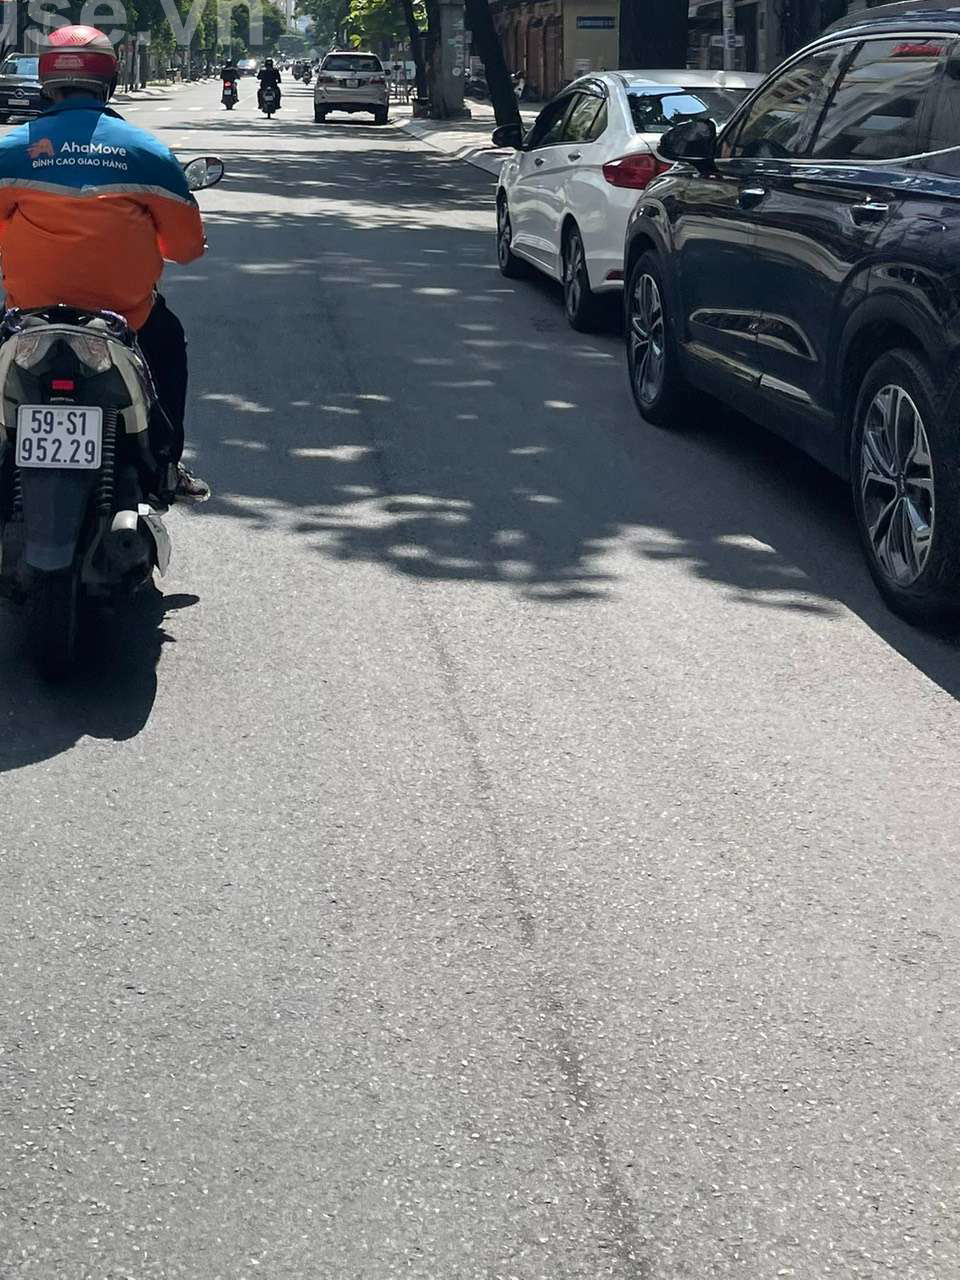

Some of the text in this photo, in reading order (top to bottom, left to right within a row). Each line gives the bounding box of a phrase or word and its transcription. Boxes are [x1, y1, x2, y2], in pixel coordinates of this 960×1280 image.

[60, 141, 127, 157] AhaMove
[55, 158, 76, 166] CAO
[77, 158, 101, 166] GIAO
[31, 409, 87, 436] 59-S1
[21, 437, 96, 464] 952.29
